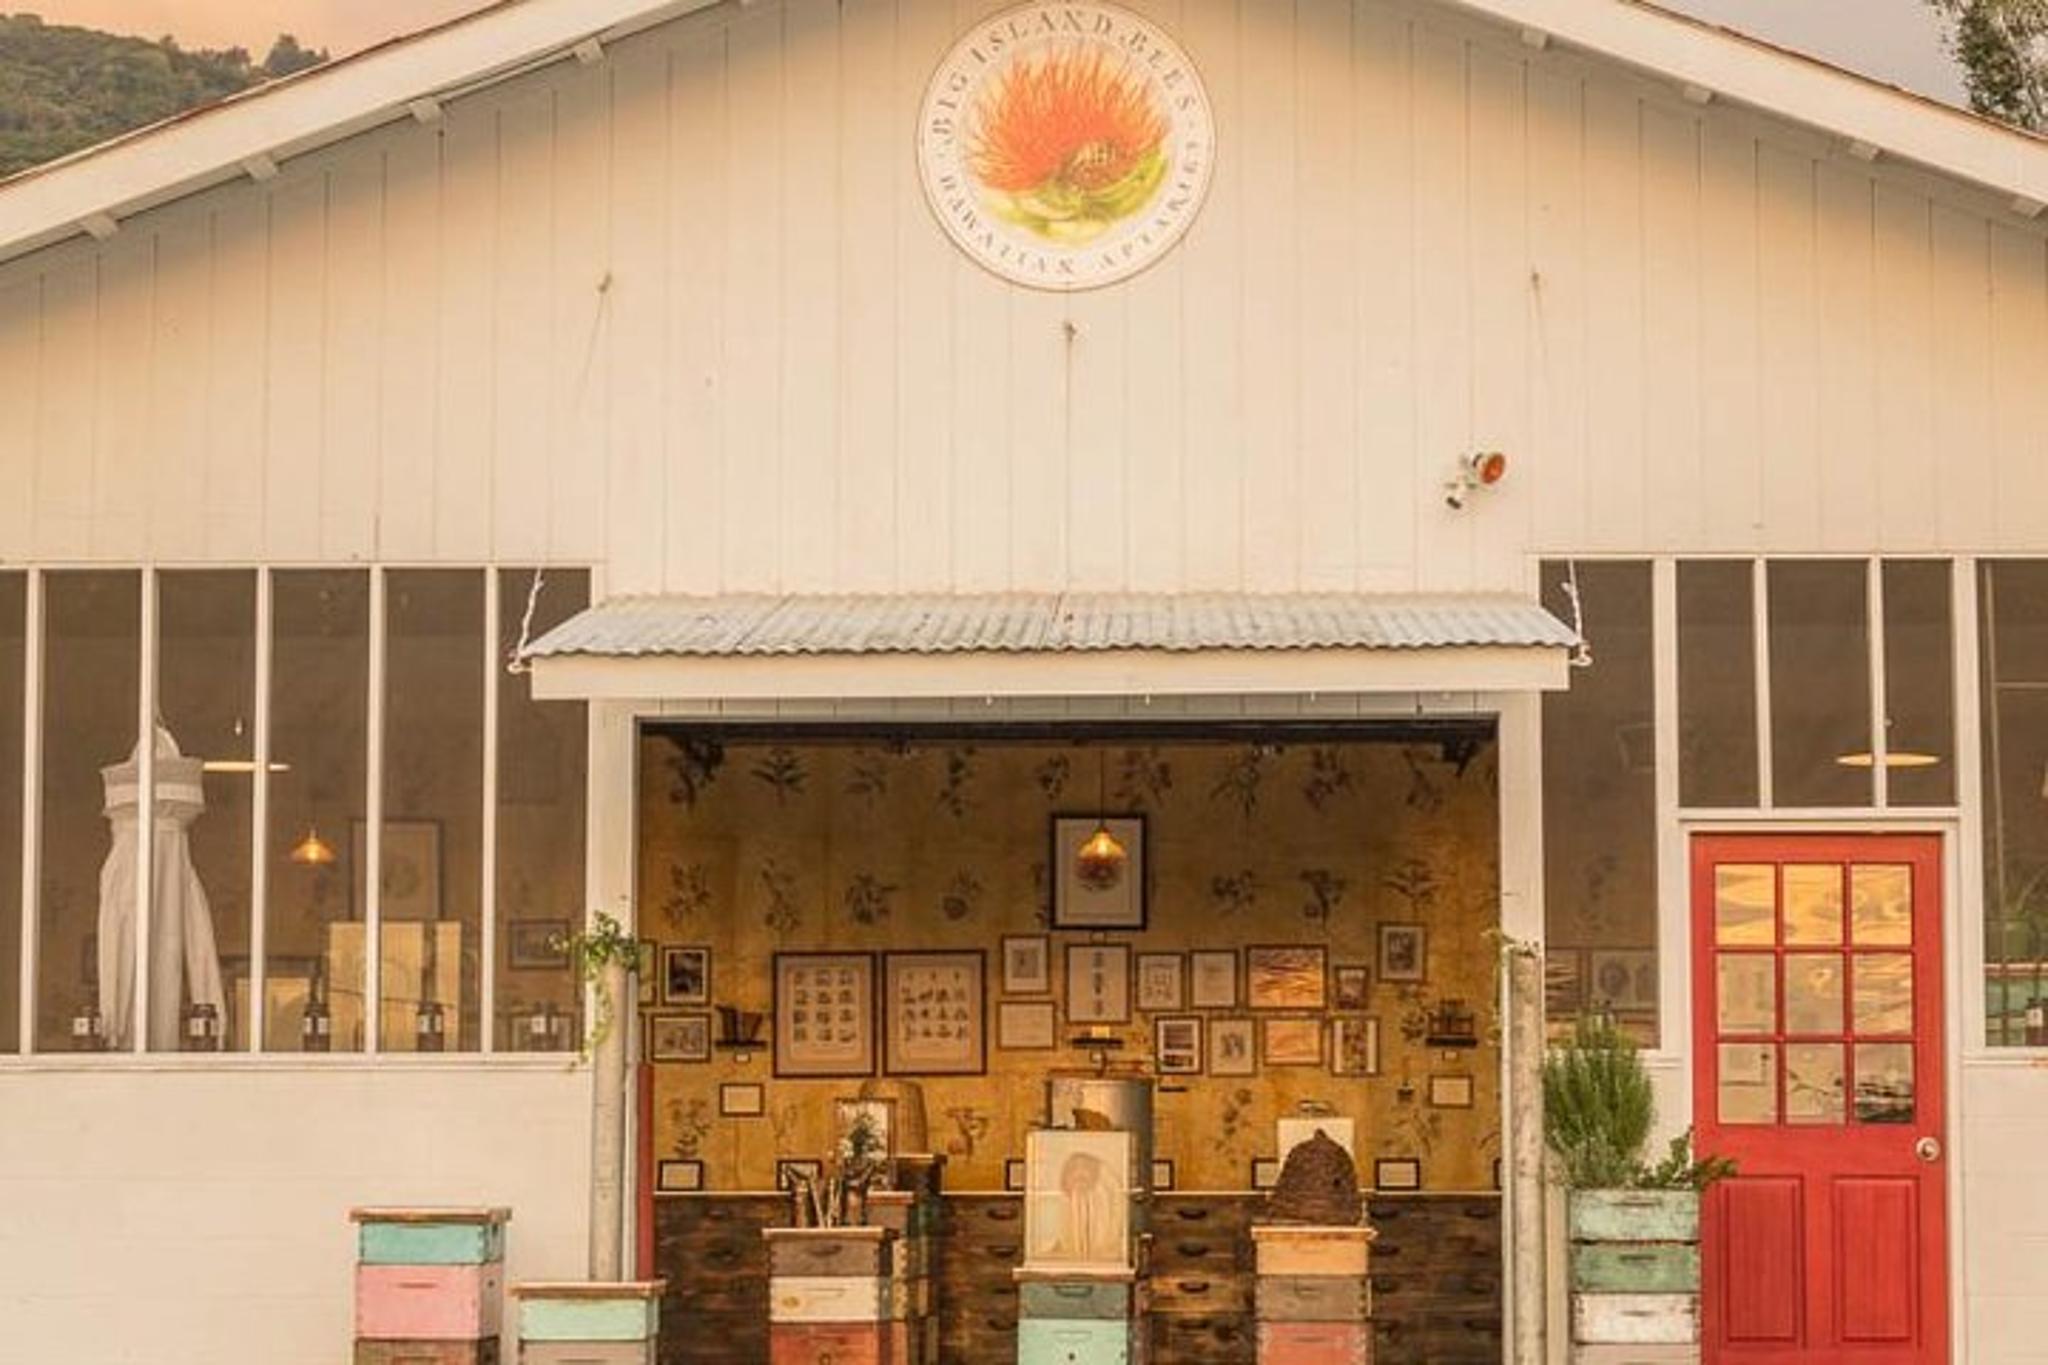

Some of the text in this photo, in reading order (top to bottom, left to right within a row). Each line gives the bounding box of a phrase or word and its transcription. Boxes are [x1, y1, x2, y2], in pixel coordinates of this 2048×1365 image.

[932, 10, 1196, 135] BIG ISLAND BEES
